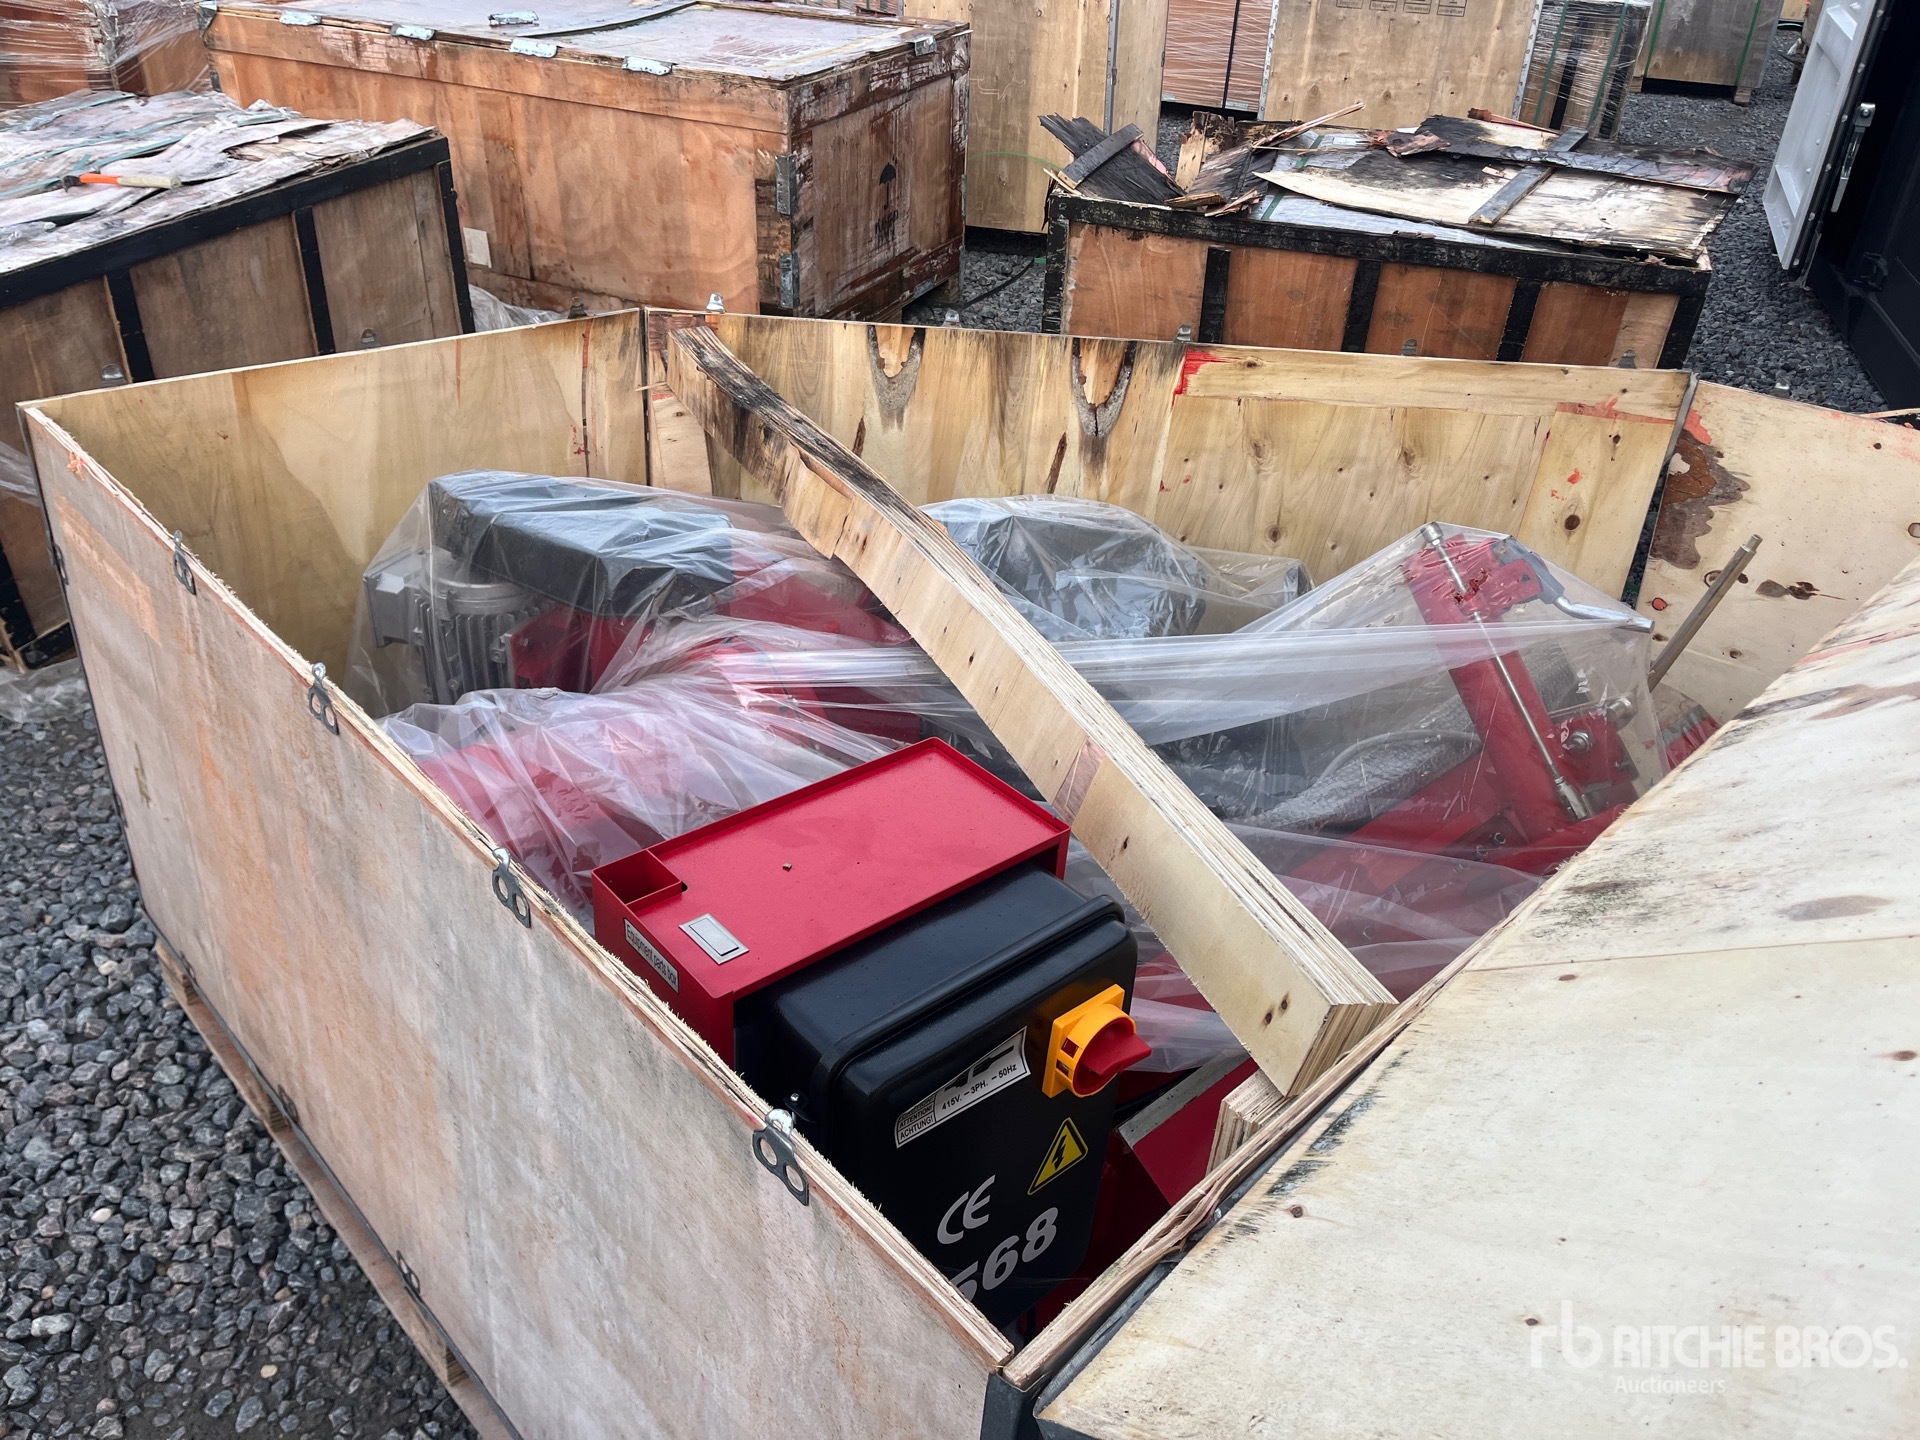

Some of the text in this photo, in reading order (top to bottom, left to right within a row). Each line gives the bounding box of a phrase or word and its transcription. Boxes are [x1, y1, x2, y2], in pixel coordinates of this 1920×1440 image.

[626, 924, 677, 985] Equipment parts box
[942, 1094, 963, 1110] 415V.
[971, 1079, 989, 1094] 3PH.
[998, 1063, 1018, 1079] 50Hz
[900, 1115, 934, 1140] ACHTUNG!
[937, 1174, 996, 1245] CE
